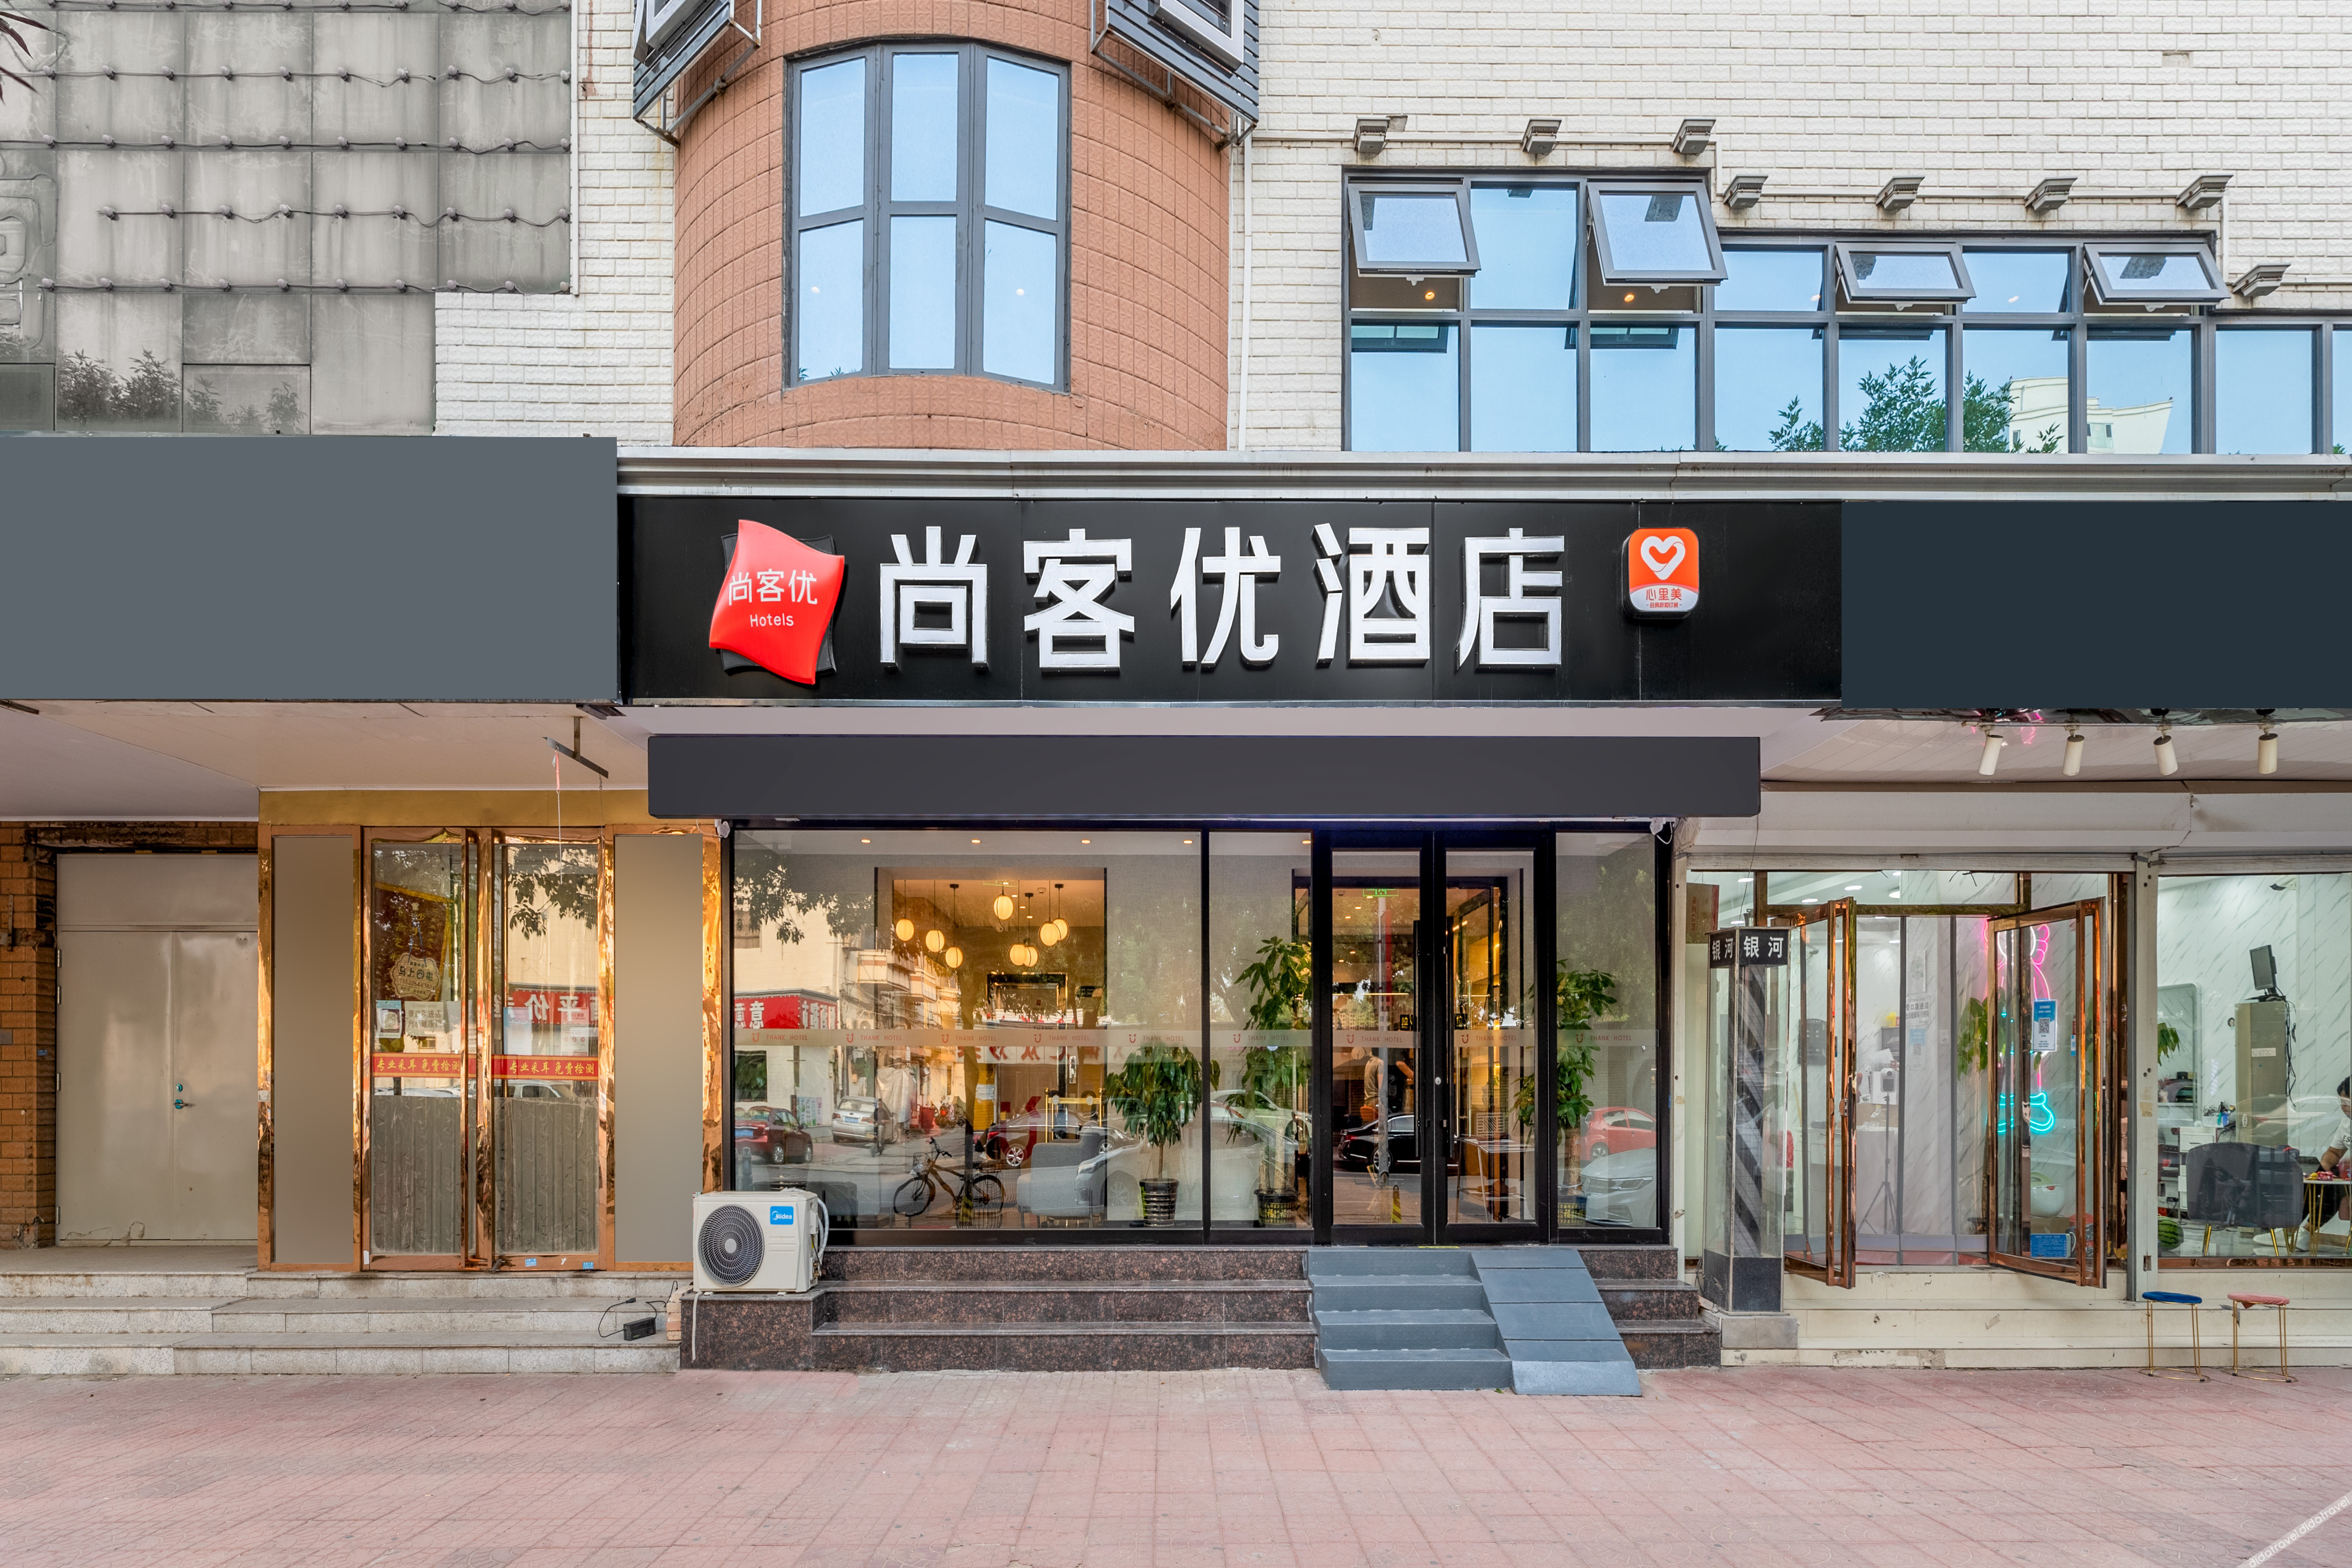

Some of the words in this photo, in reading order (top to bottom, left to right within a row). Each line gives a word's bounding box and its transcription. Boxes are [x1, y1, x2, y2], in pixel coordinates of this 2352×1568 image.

[729, 568, 818, 606] 尚客优
[1646, 588, 1682, 601] 心里美
[880, 522, 1565, 669] 尚客优酒店
[750, 613, 794, 627] Hotels
[1712, 938, 1734, 961] 银河
[1743, 936, 1784, 958] 银河
[399, 966, 433, 982] 马上回来
[1401, 1016, 1408, 1025] 拉
[377, 1058, 417, 1071] 专业采耳
[421, 1058, 461, 1073] 免费检测
[509, 1060, 550, 1074] 专业采耳
[555, 1061, 595, 1075] 免费检测
